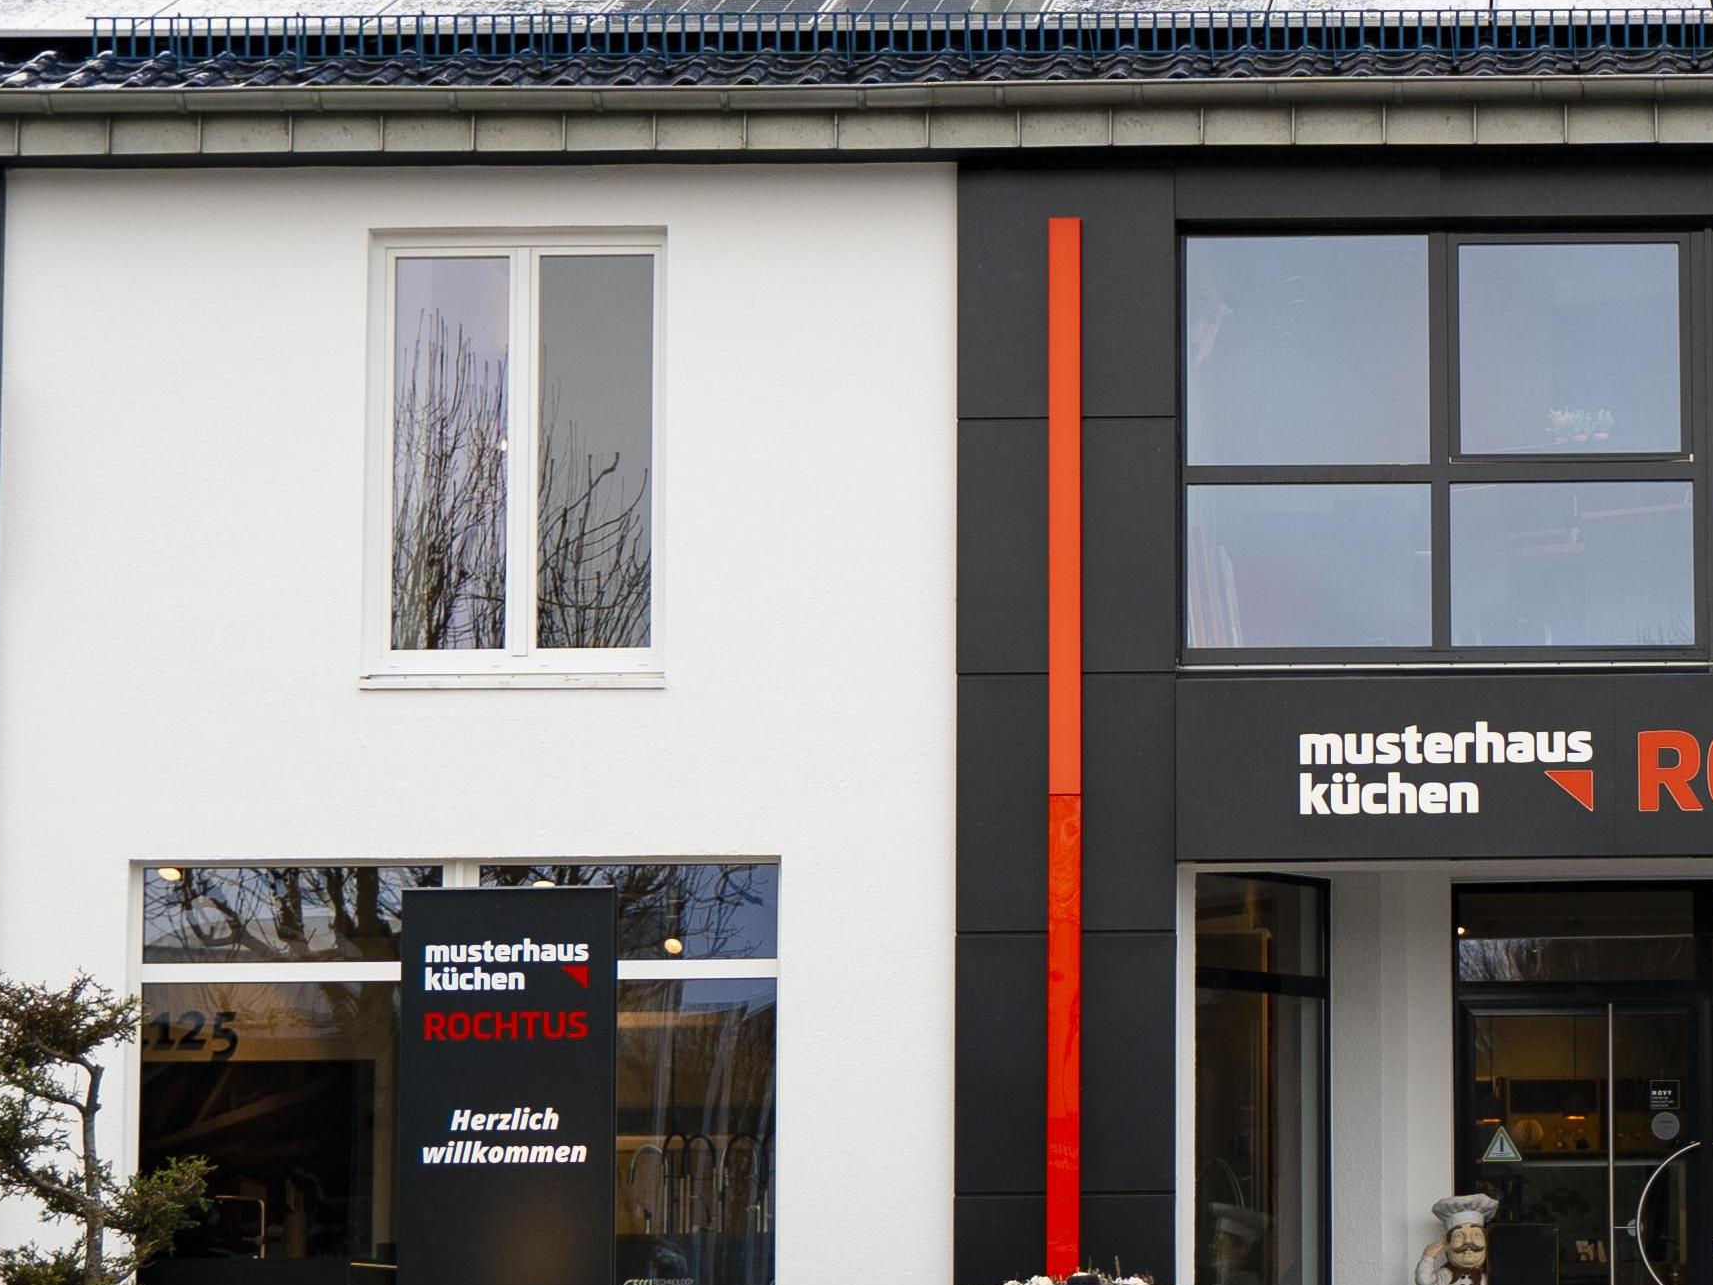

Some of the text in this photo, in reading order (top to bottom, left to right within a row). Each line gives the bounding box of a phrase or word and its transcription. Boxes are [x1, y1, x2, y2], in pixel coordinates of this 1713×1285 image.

[1299, 721, 1593, 764] musterhaus
[1299, 771, 1480, 815] küchen
[424, 938, 589, 963] musterhaus
[424, 966, 526, 991] küchen
[423, 1010, 589, 1041] ROCHTUS
[450, 1107, 560, 1131] Herzlich
[422, 1140, 588, 1164] willkommen
